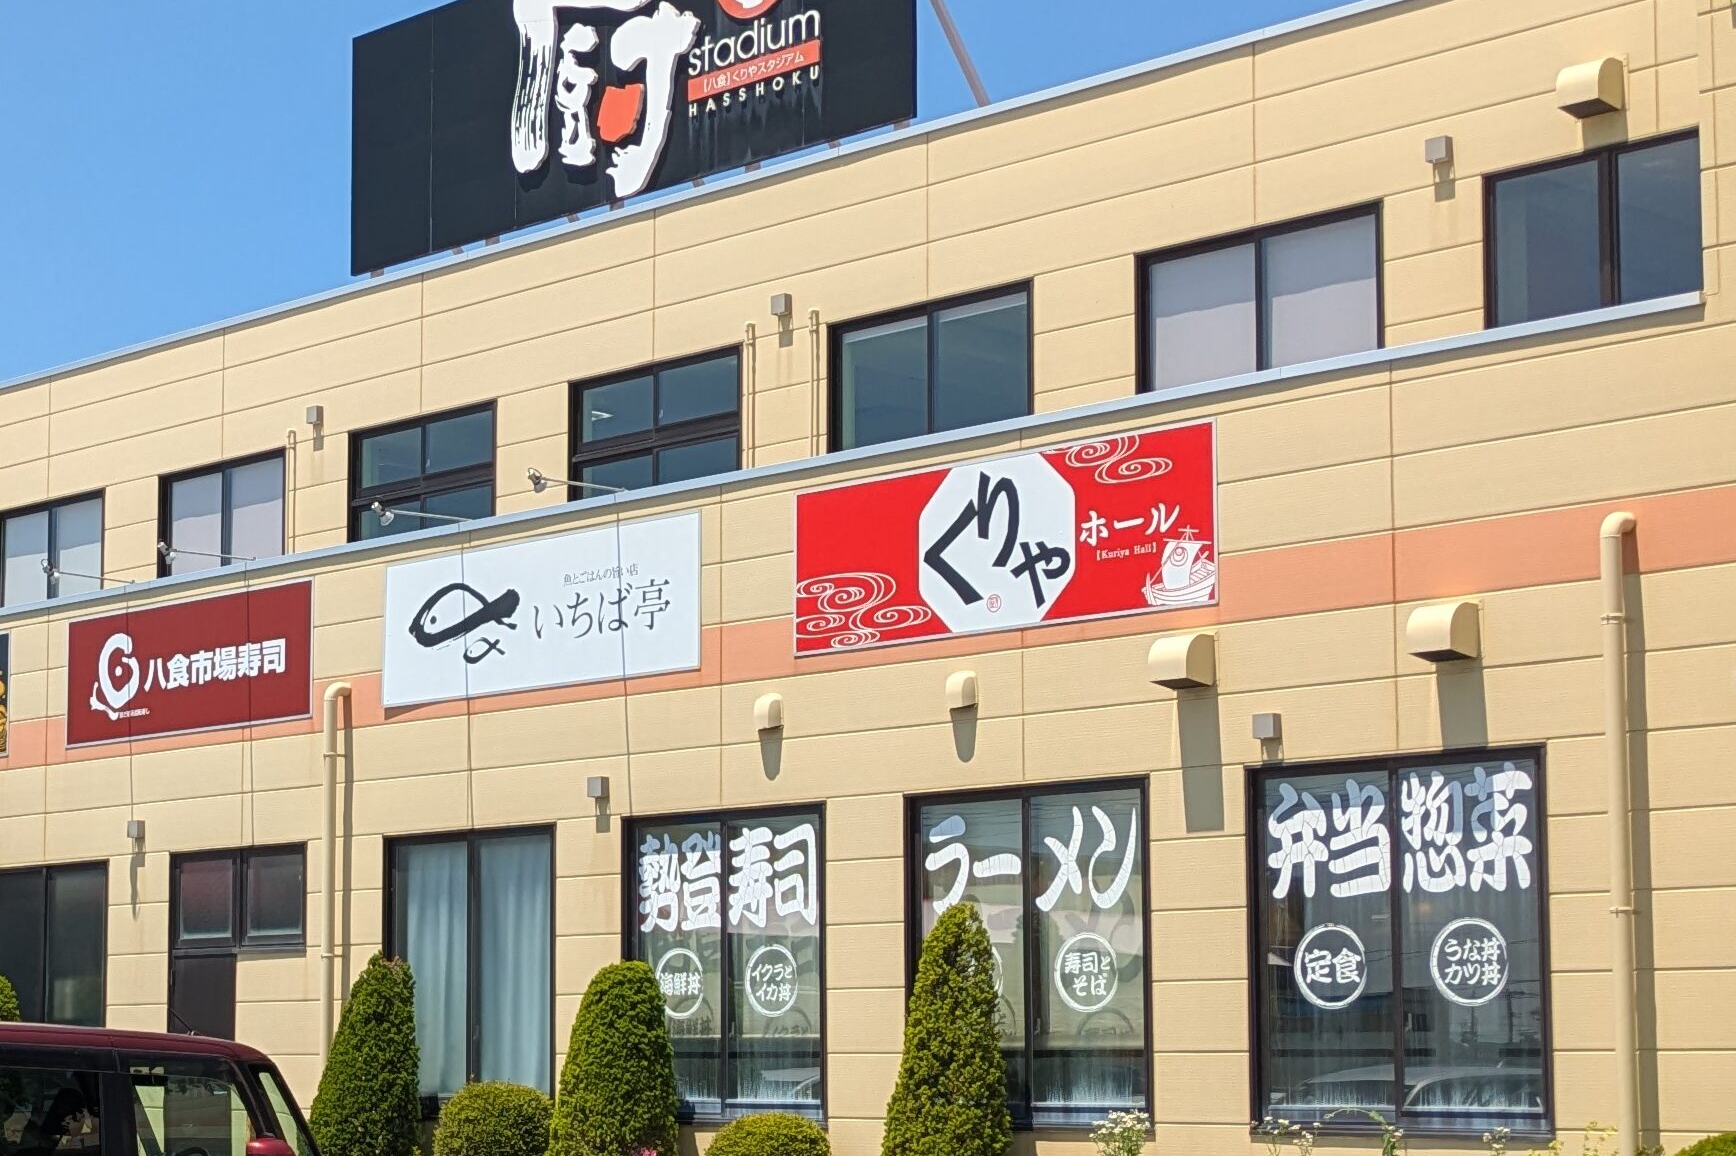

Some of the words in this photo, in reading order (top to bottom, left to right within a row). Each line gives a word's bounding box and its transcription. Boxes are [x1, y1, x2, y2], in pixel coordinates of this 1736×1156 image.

[688, 9, 821, 75] stadium
[688, 64, 819, 117] HASSHOKU
[923, 470, 1071, 609] くりや
[1080, 502, 1180, 546] ホール
[532, 578, 670, 640] いちば亭
[144, 638, 286, 692] 八食市場寿司
[925, 805, 1136, 916] ラーメン
[1064, 951, 1111, 974] 寿司と
[1304, 947, 1362, 984] 定食
[1444, 937, 1501, 962] うな丼
[660, 971, 701, 996] 海鮮丼
[751, 962, 793, 982] イクラと
[1072, 973, 1107, 997] そば
[1444, 962, 1501, 986] カツ丼
[755, 982, 793, 1002] イカ丼
